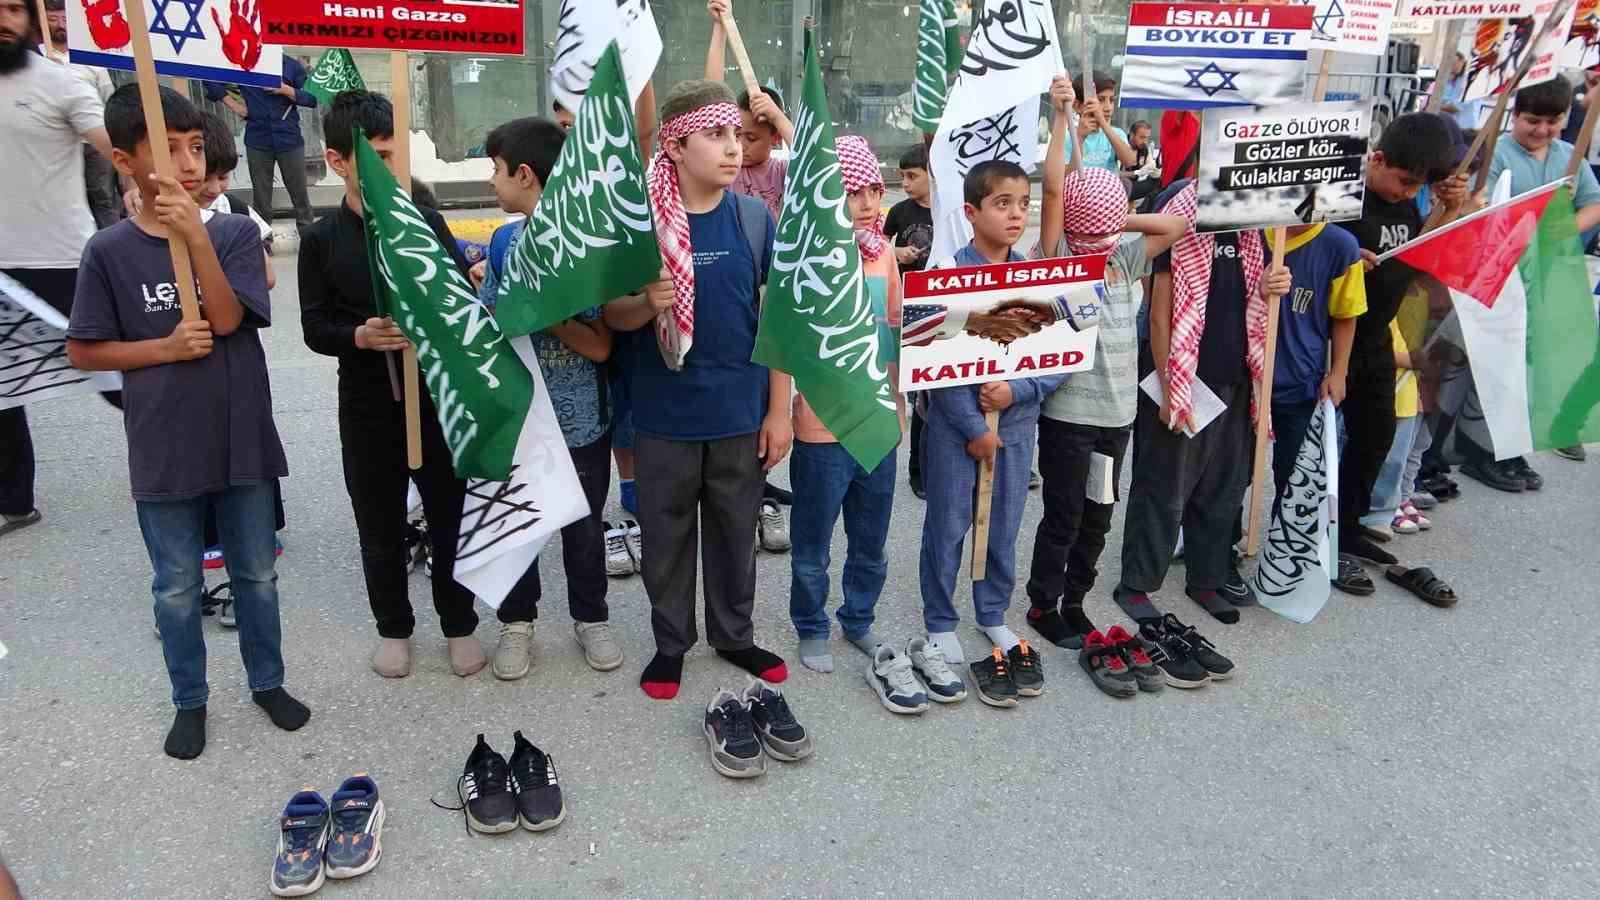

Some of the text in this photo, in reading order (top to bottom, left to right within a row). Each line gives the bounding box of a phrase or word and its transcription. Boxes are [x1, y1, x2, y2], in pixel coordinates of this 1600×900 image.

[323, 3, 467, 24] Hani Gazze
[1165, 6, 1271, 27] İSRAİLİ
[1411, 4, 1484, 17] KATLİAM
[1488, 3, 1522, 14] VAR
[267, 21, 375, 39] KIRMIZI
[1145, 29, 1296, 45] BOYKOT ET
[1224, 121, 1283, 139] Gazze
[1287, 117, 1350, 136] ÖLÜYOR
[1246, 139, 1344, 161] Gözler kör..
[1230, 166, 1300, 187] Kulaklar
[927, 262, 1088, 291] KATİL İSRAİL
[911, 350, 1085, 384] KATİL ABD
